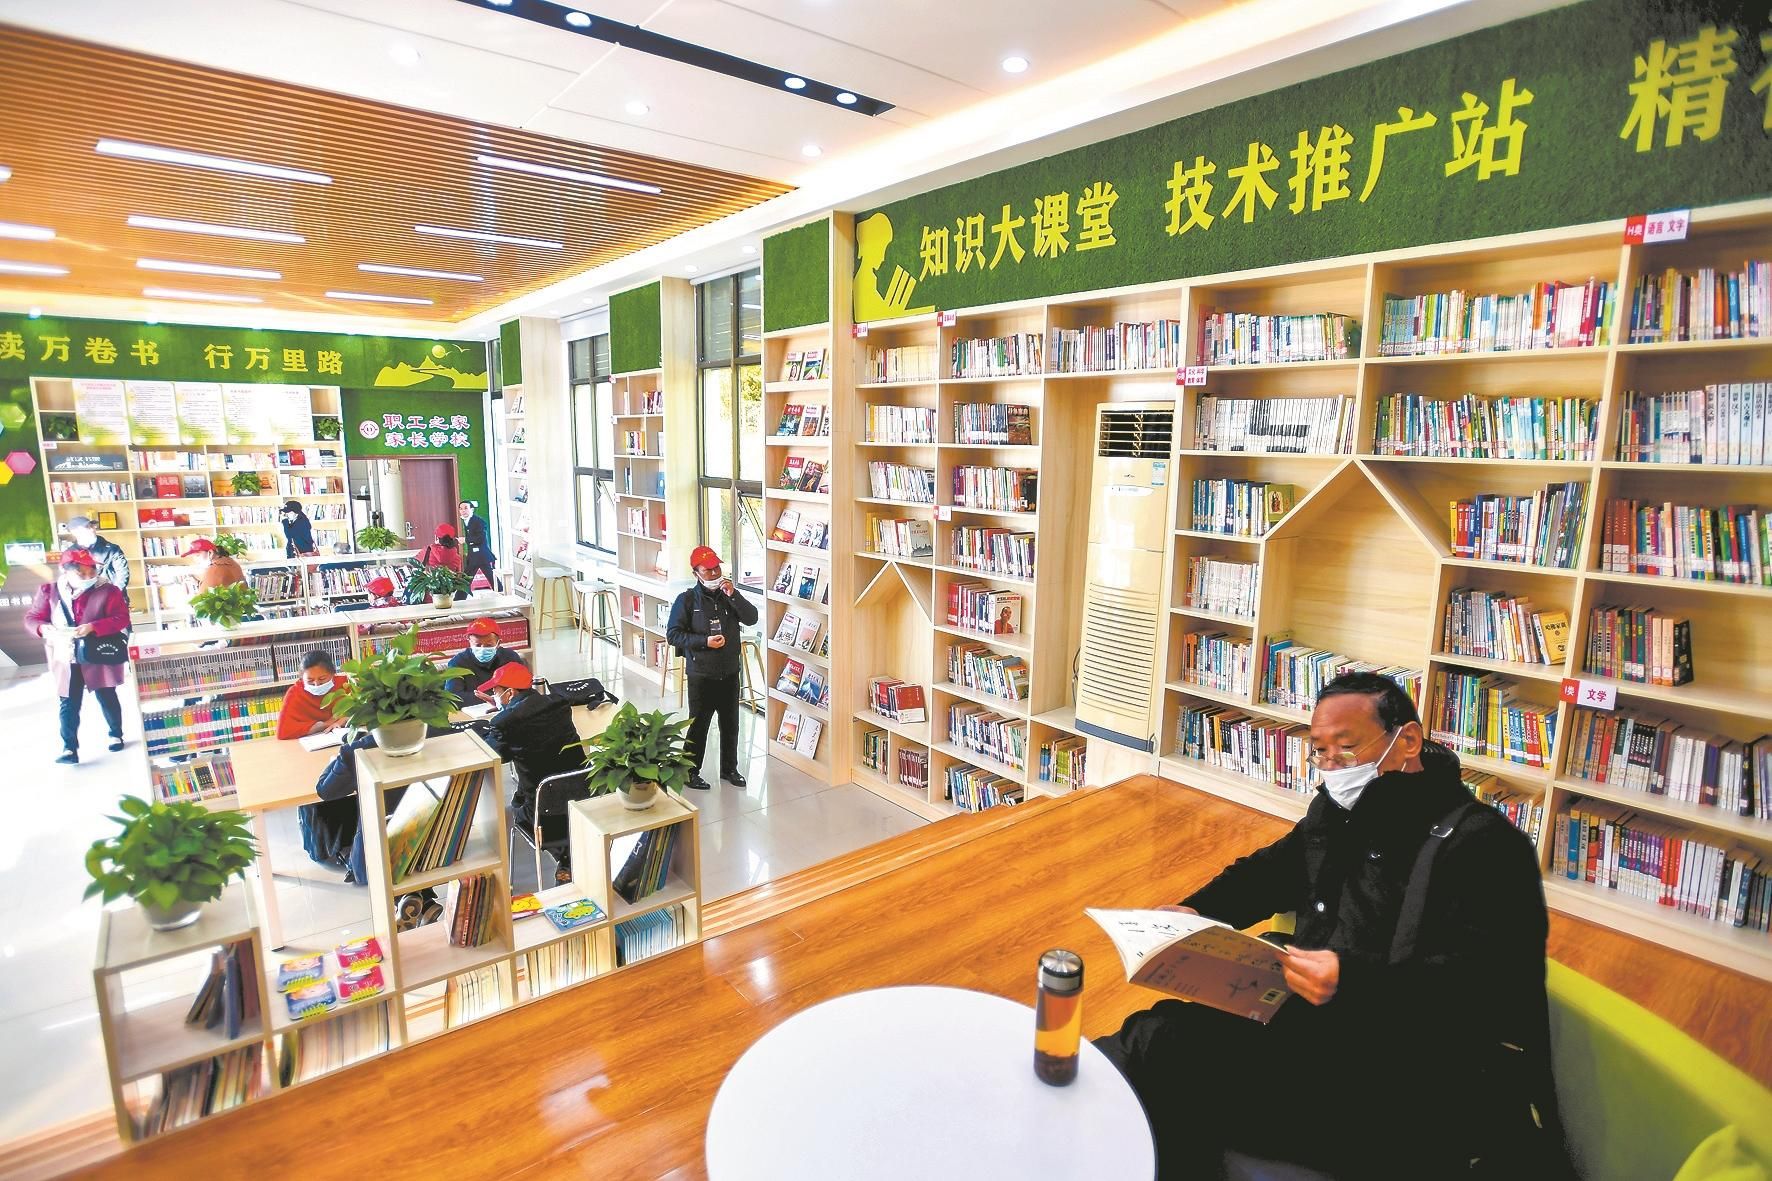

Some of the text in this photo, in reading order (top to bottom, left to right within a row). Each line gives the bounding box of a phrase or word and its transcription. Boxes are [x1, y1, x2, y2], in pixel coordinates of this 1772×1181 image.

[919, 12, 1772, 282] 知识大课堂 技术推广站 精
[1667, 218, 1685, 233] 文字
[203, 342, 343, 375] 行万里路
[383, 414, 471, 430] 职工之家
[384, 431, 471, 448] 家长学校
[1586, 688, 1607, 702] 文学
